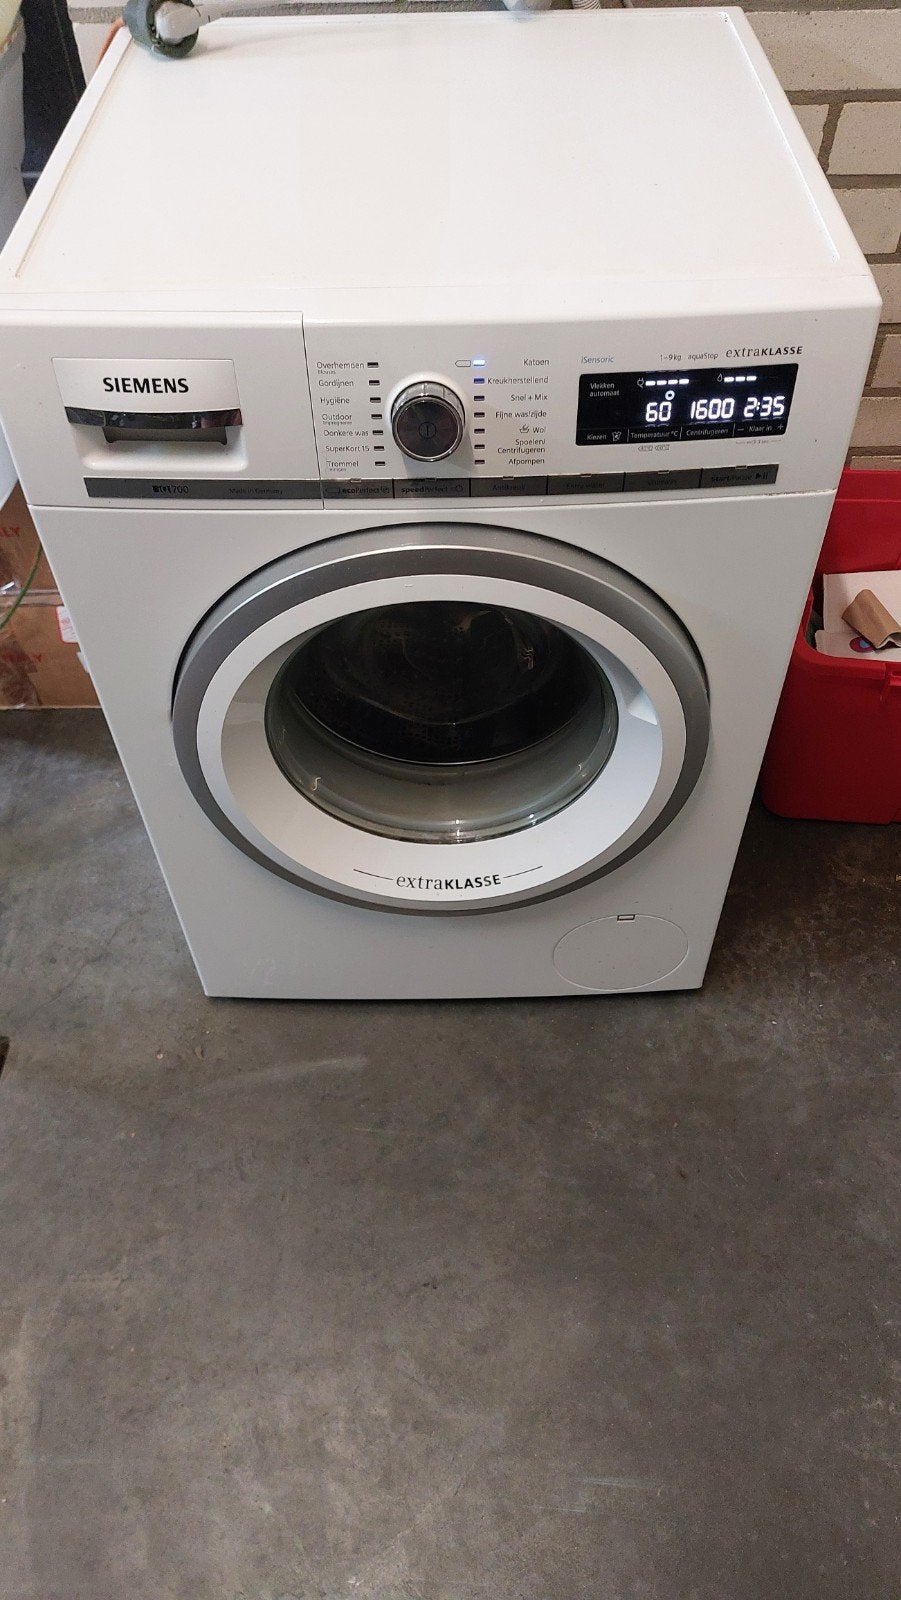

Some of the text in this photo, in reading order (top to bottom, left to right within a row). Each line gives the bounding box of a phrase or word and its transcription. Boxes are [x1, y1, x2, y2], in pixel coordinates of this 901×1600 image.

[725, 346, 803, 358] extraKLASSE
[687, 353, 719, 361] aquaStop
[316, 361, 365, 369] Overhemden
[523, 358, 550, 366] Katoen
[318, 379, 354, 388] Gordijnen
[487, 376, 549, 385] Kreukherstellend
[102, 377, 189, 394] SIEMENS
[320, 397, 350, 405] Hygiëne
[510, 394, 526, 402] Snel
[534, 393, 548, 401] Mix
[645, 401, 672, 422] 60
[690, 397, 735, 420] 1600
[743, 396, 786, 418] 2:35
[322, 413, 353, 421] Outdoor
[495, 411, 513, 419] Fijne
[323, 429, 354, 437] Donkere
[686, 428, 729, 437] Centrifugeren
[325, 445, 361, 453] SuperKort
[497, 446, 546, 455] Centrifugeren
[508, 457, 545, 466] Afpompen
[396, 874, 501, 890] extraKLASSE
